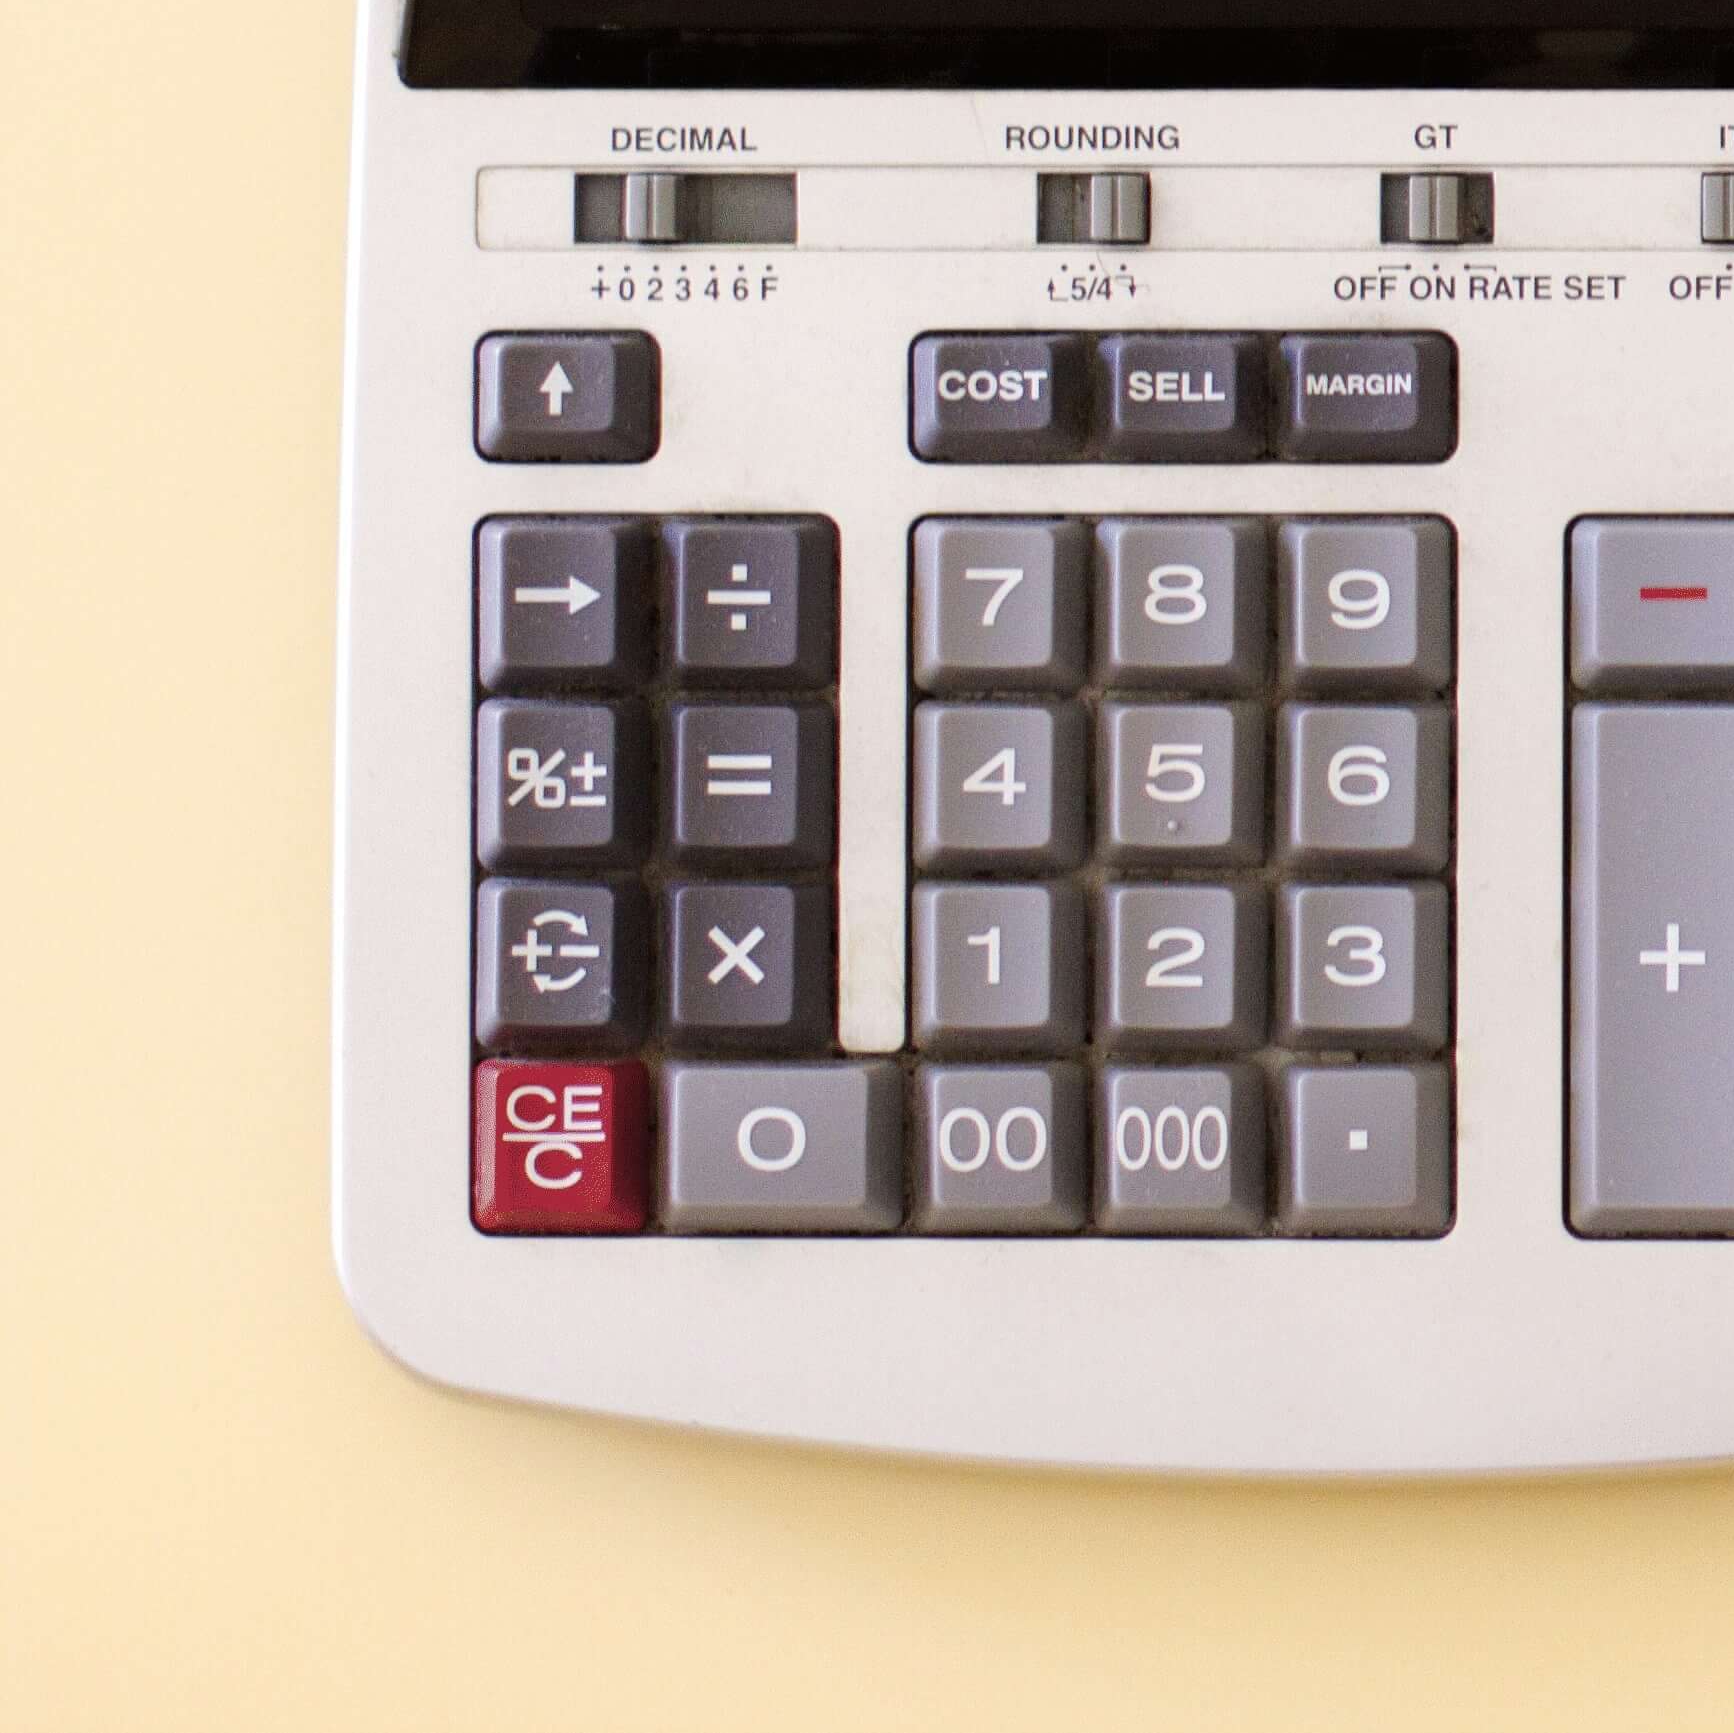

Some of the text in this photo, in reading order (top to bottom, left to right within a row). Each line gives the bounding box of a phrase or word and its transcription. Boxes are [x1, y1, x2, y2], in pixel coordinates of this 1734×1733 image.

[611, 127, 757, 152] DECIMAL
[1005, 125, 1180, 150] ROUNDING
[1414, 124, 1458, 149] GT
[618, 277, 635, 301] 0
[647, 277, 663, 301] 2
[675, 277, 691, 301] 3
[703, 277, 719, 300] 4
[732, 277, 749, 301] 6
[761, 277, 777, 301] F
[1333, 275, 1626, 301] OFF ON RATE SET
[1669, 275, 1732, 300] OFF
[938, 369, 1048, 402] COST
[1128, 371, 1226, 402] SELL
[1306, 372, 1412, 396] MARGIN
[965, 567, 1024, 626] 7
[1144, 564, 1207, 625] 8
[1328, 568, 1391, 630] 9
[963, 747, 1027, 806] 4
[1145, 743, 1206, 802] 5
[1327, 745, 1390, 806] 6
[967, 926, 1001, 985] 1
[1145, 927, 1205, 988] 2
[1324, 925, 1387, 987] 3
[506, 1084, 605, 1133] CE
[1116, 1104, 1228, 1171] 000
[523, 1144, 583, 1190] C
[737, 1106, 806, 1172] 0
[938, 1106, 1047, 1173] 00
